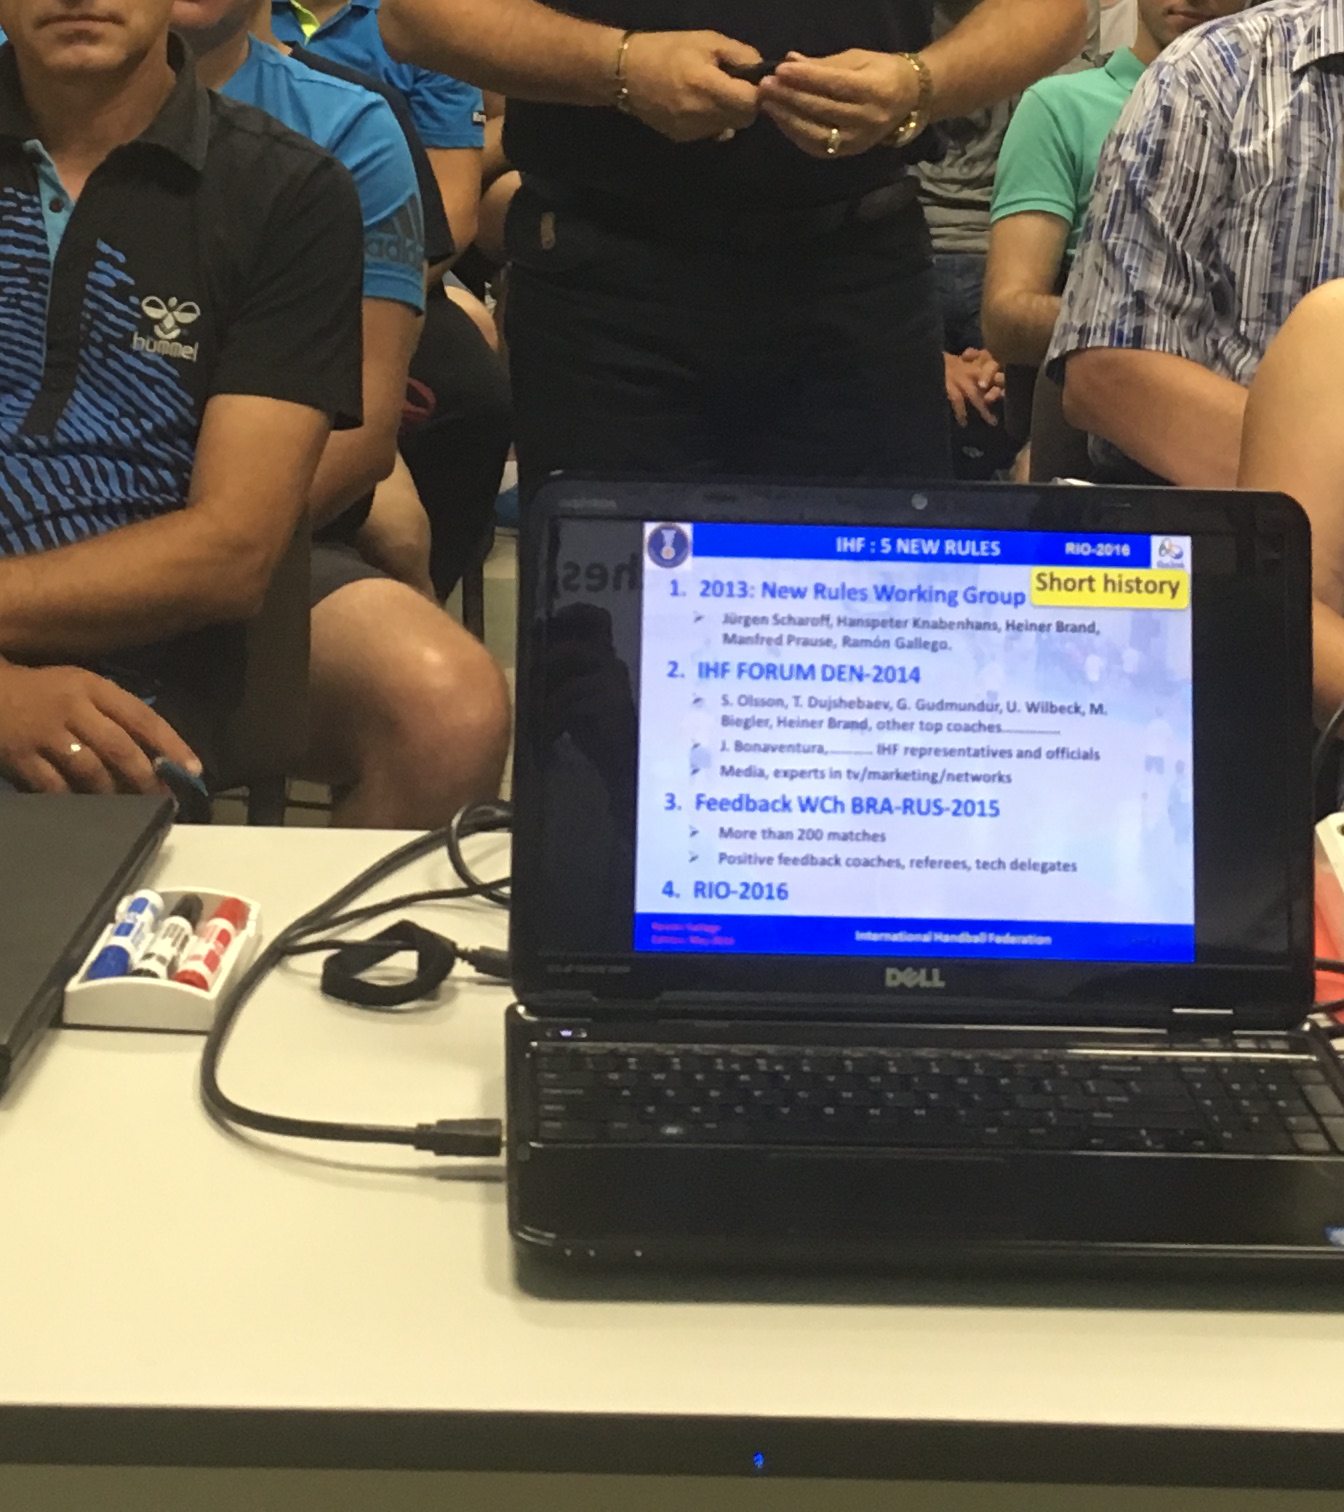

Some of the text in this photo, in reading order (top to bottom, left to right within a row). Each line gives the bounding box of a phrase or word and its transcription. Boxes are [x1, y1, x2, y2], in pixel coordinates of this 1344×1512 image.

[131, 330, 199, 363] hummel
[835, 537, 866, 554] IHF
[880, 538, 892, 554] 5
[896, 538, 940, 555] NEW
[945, 539, 1001, 557] RULES
[1065, 541, 1131, 557] RIO-2016
[669, 579, 1026, 609] 1. 2013: New Rules Working Group
[1035, 572, 1181, 600] Short history
[722, 612, 769, 628] Jürgen
[836, 615, 909, 630] Hanspeter
[912, 617, 1002, 633] Knabenhans,
[1006, 619, 1052, 633] Heiner
[722, 632, 783, 647] Manfred
[842, 634, 891, 650] Ramón
[895, 636, 952, 653] Gallego.
[666, 660, 921, 684] 2. IHF FORUM DEN-2014
[776, 716, 824, 729] Heiner
[876, 719, 915, 732] other
[918, 719, 943, 734] top
[877, 742, 900, 756] IHF
[903, 744, 1013, 759] representatives
[1016, 746, 1042, 760] and
[1045, 747, 1101, 761] officials
[719, 765, 1013, 785] Media, experts in tv/marketing/networks
[663, 792, 1001, 818] 3. Feedback WCh BRA-RUS-2015
[718, 827, 887, 843] More than 200 matches
[718, 852, 1078, 875] Positive feedback coaches, referees, tech delegates
[661, 880, 789, 901] 4. RIO-2016
[884, 967, 946, 988] DELL
